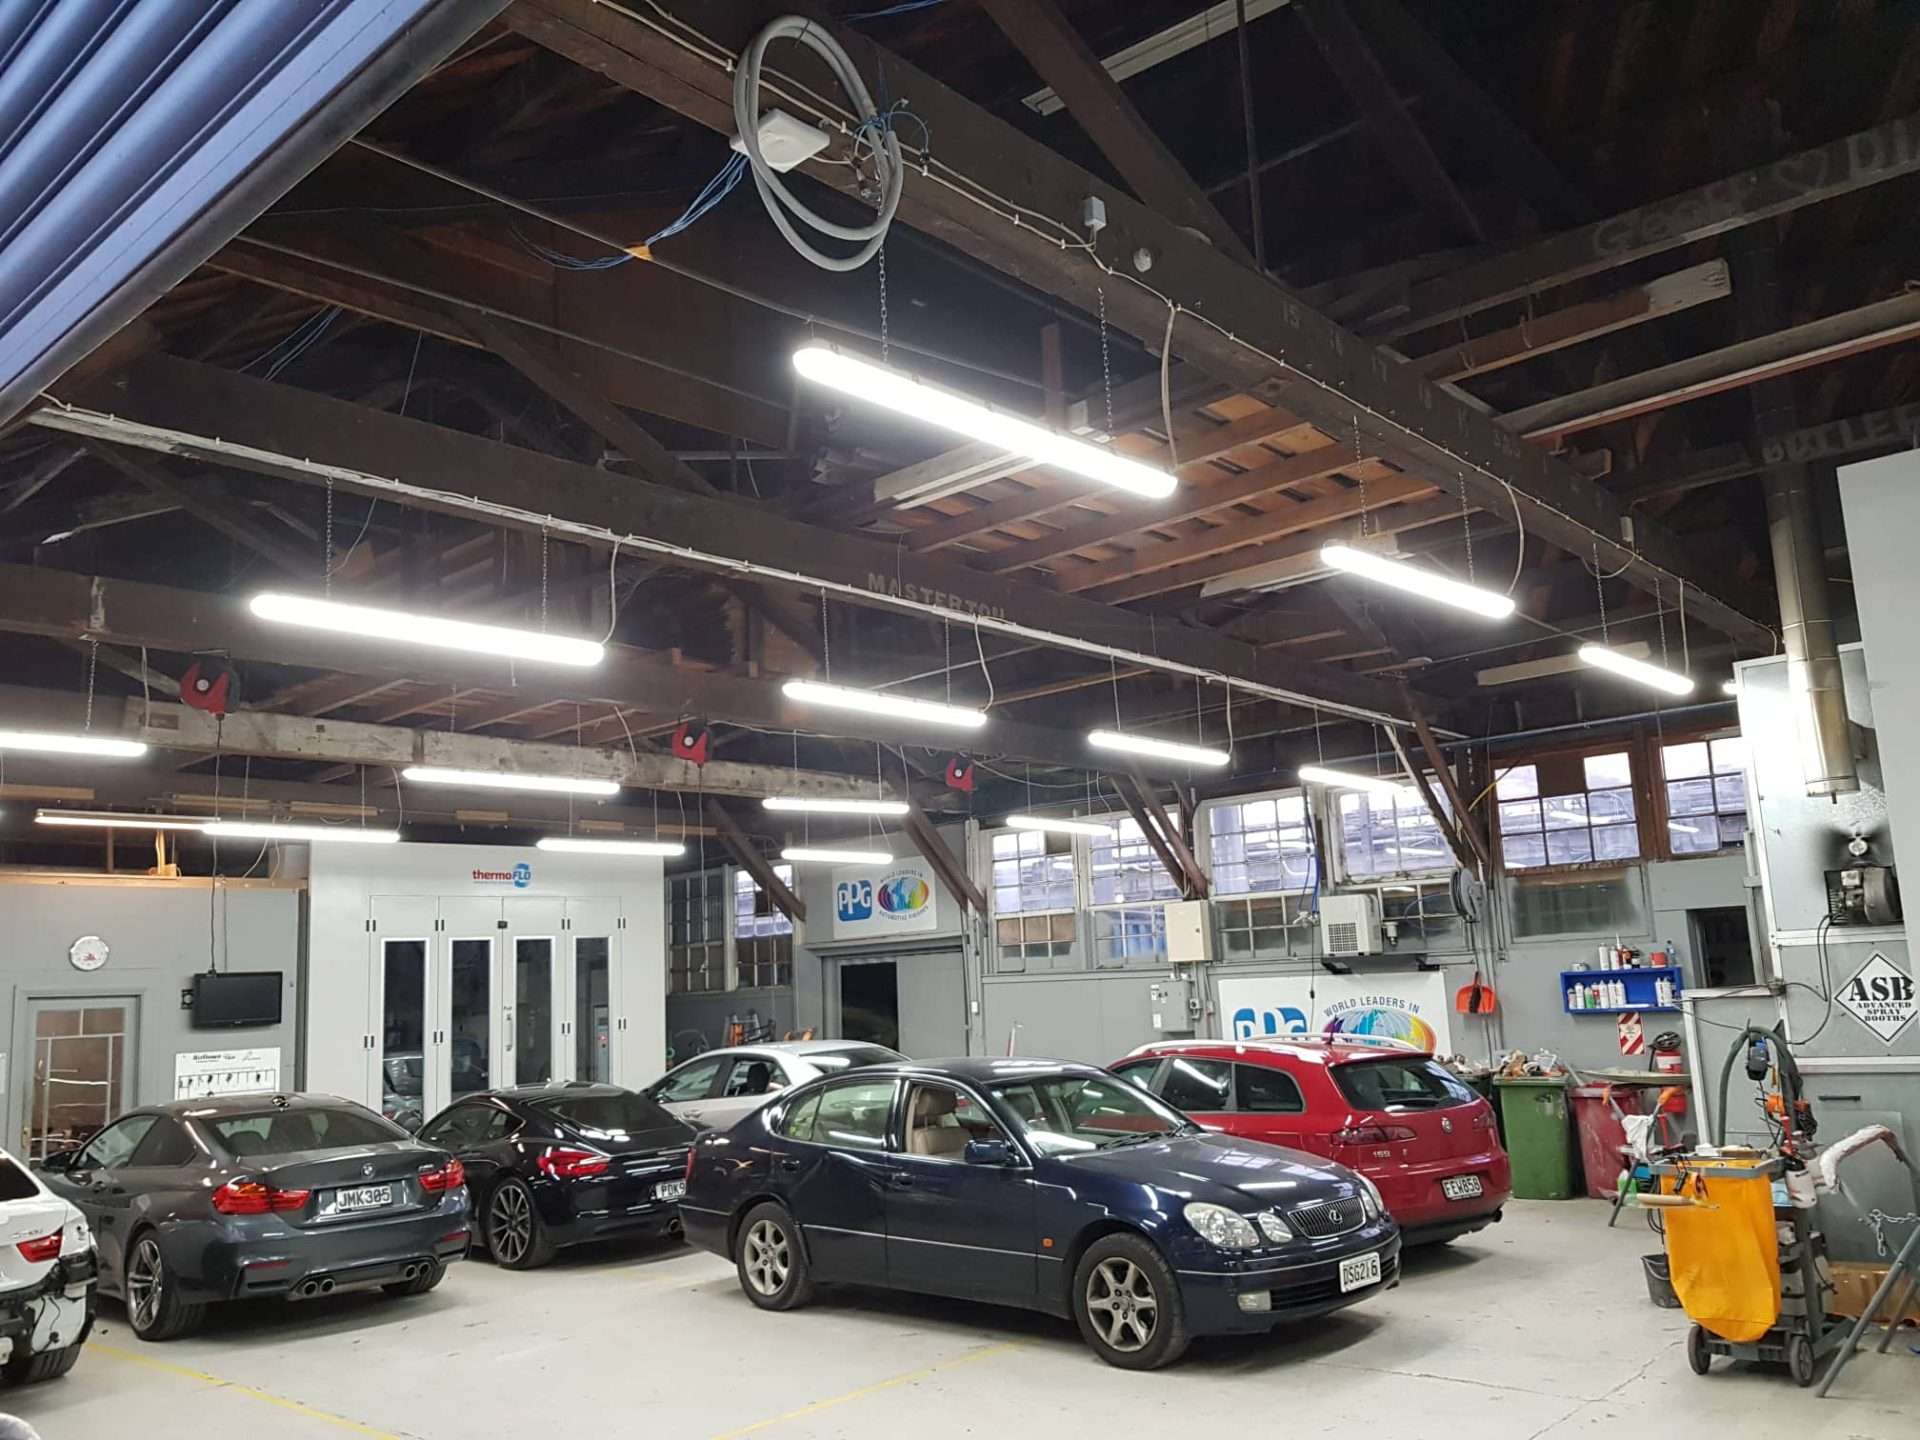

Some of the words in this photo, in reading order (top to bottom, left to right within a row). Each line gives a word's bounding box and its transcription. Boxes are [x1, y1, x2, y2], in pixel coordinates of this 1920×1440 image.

[838, 882, 871, 915] PPG
[1848, 976, 1915, 1001] ASB
[1324, 998, 1357, 1017] WORLD
[1360, 996, 1406, 1009] LEADERS
[1408, 1002, 1420, 1014] IN
[338, 1187, 390, 1208] JMK305
[1445, 1178, 1481, 1195] FEW858
[1343, 1257, 1378, 1285] DSG216
